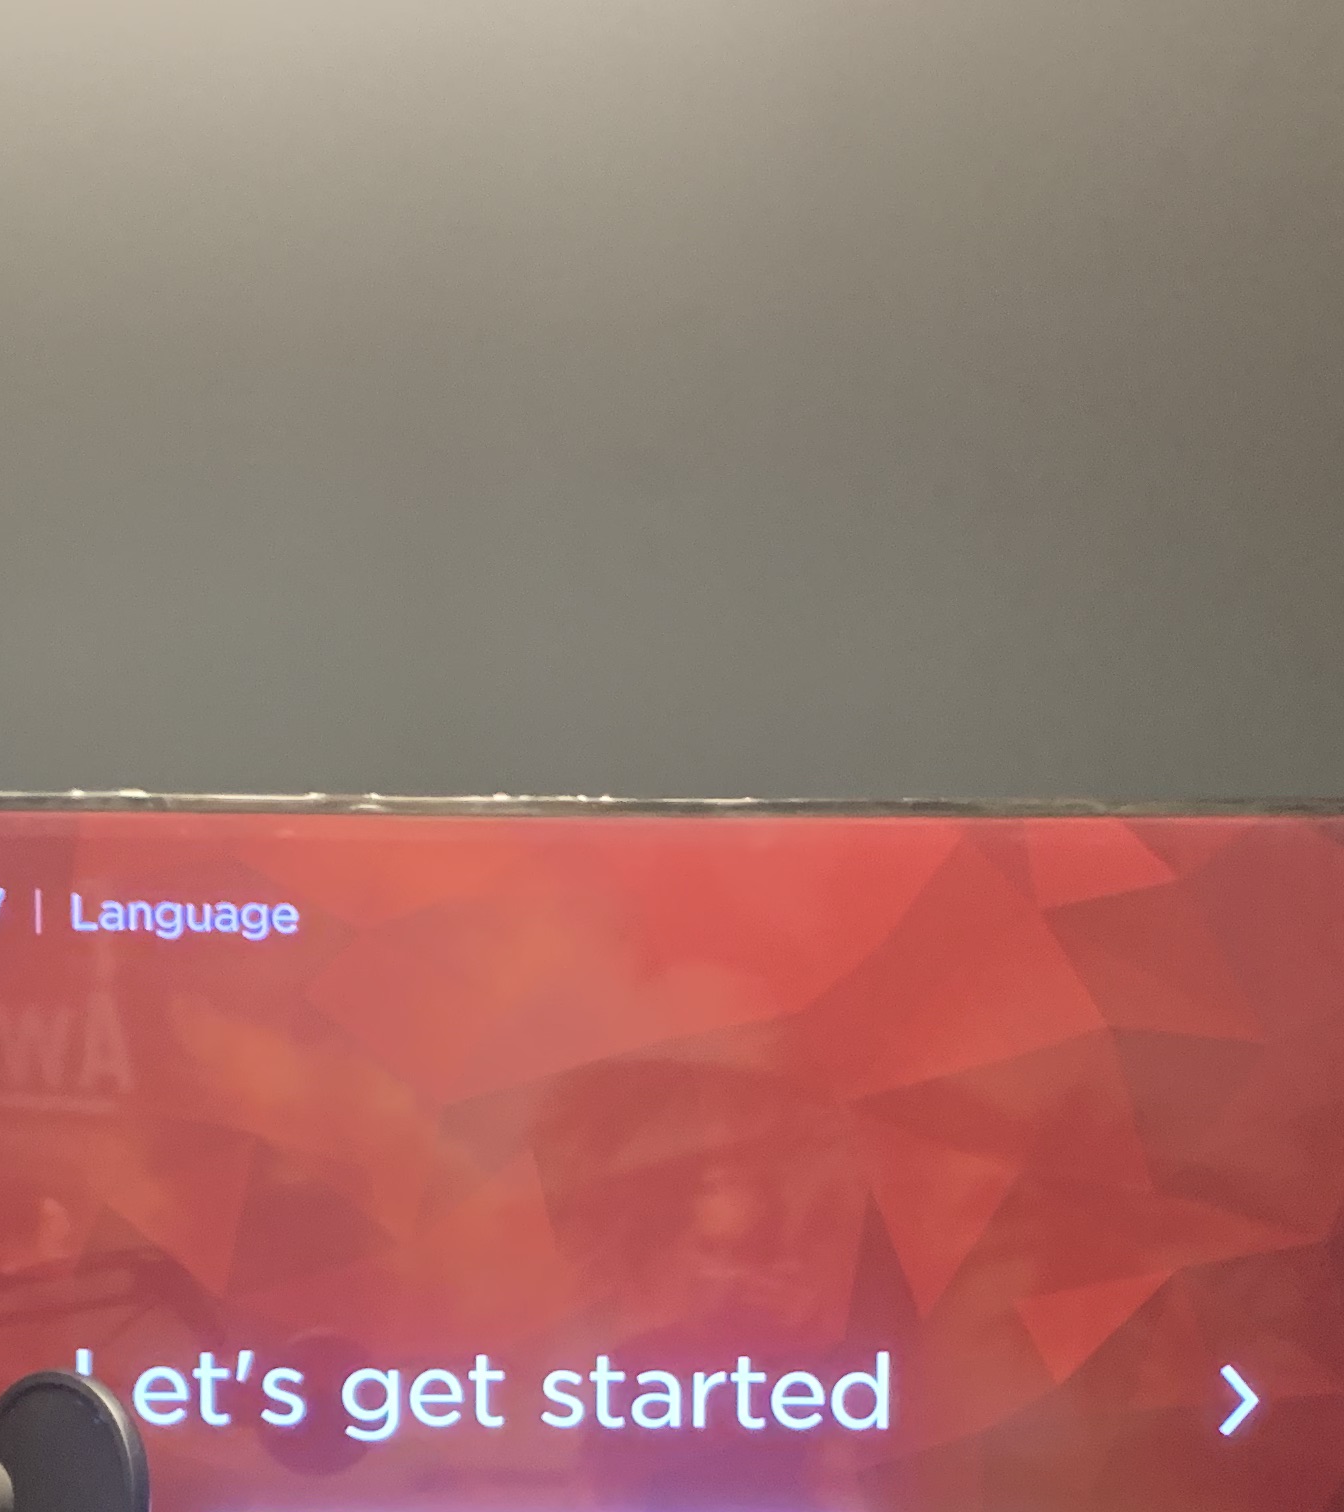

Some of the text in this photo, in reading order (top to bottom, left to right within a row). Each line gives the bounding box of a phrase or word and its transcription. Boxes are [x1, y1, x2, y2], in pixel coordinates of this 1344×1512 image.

[70, 892, 300, 941] Language
[75, 1348, 890, 1443] et's get started
